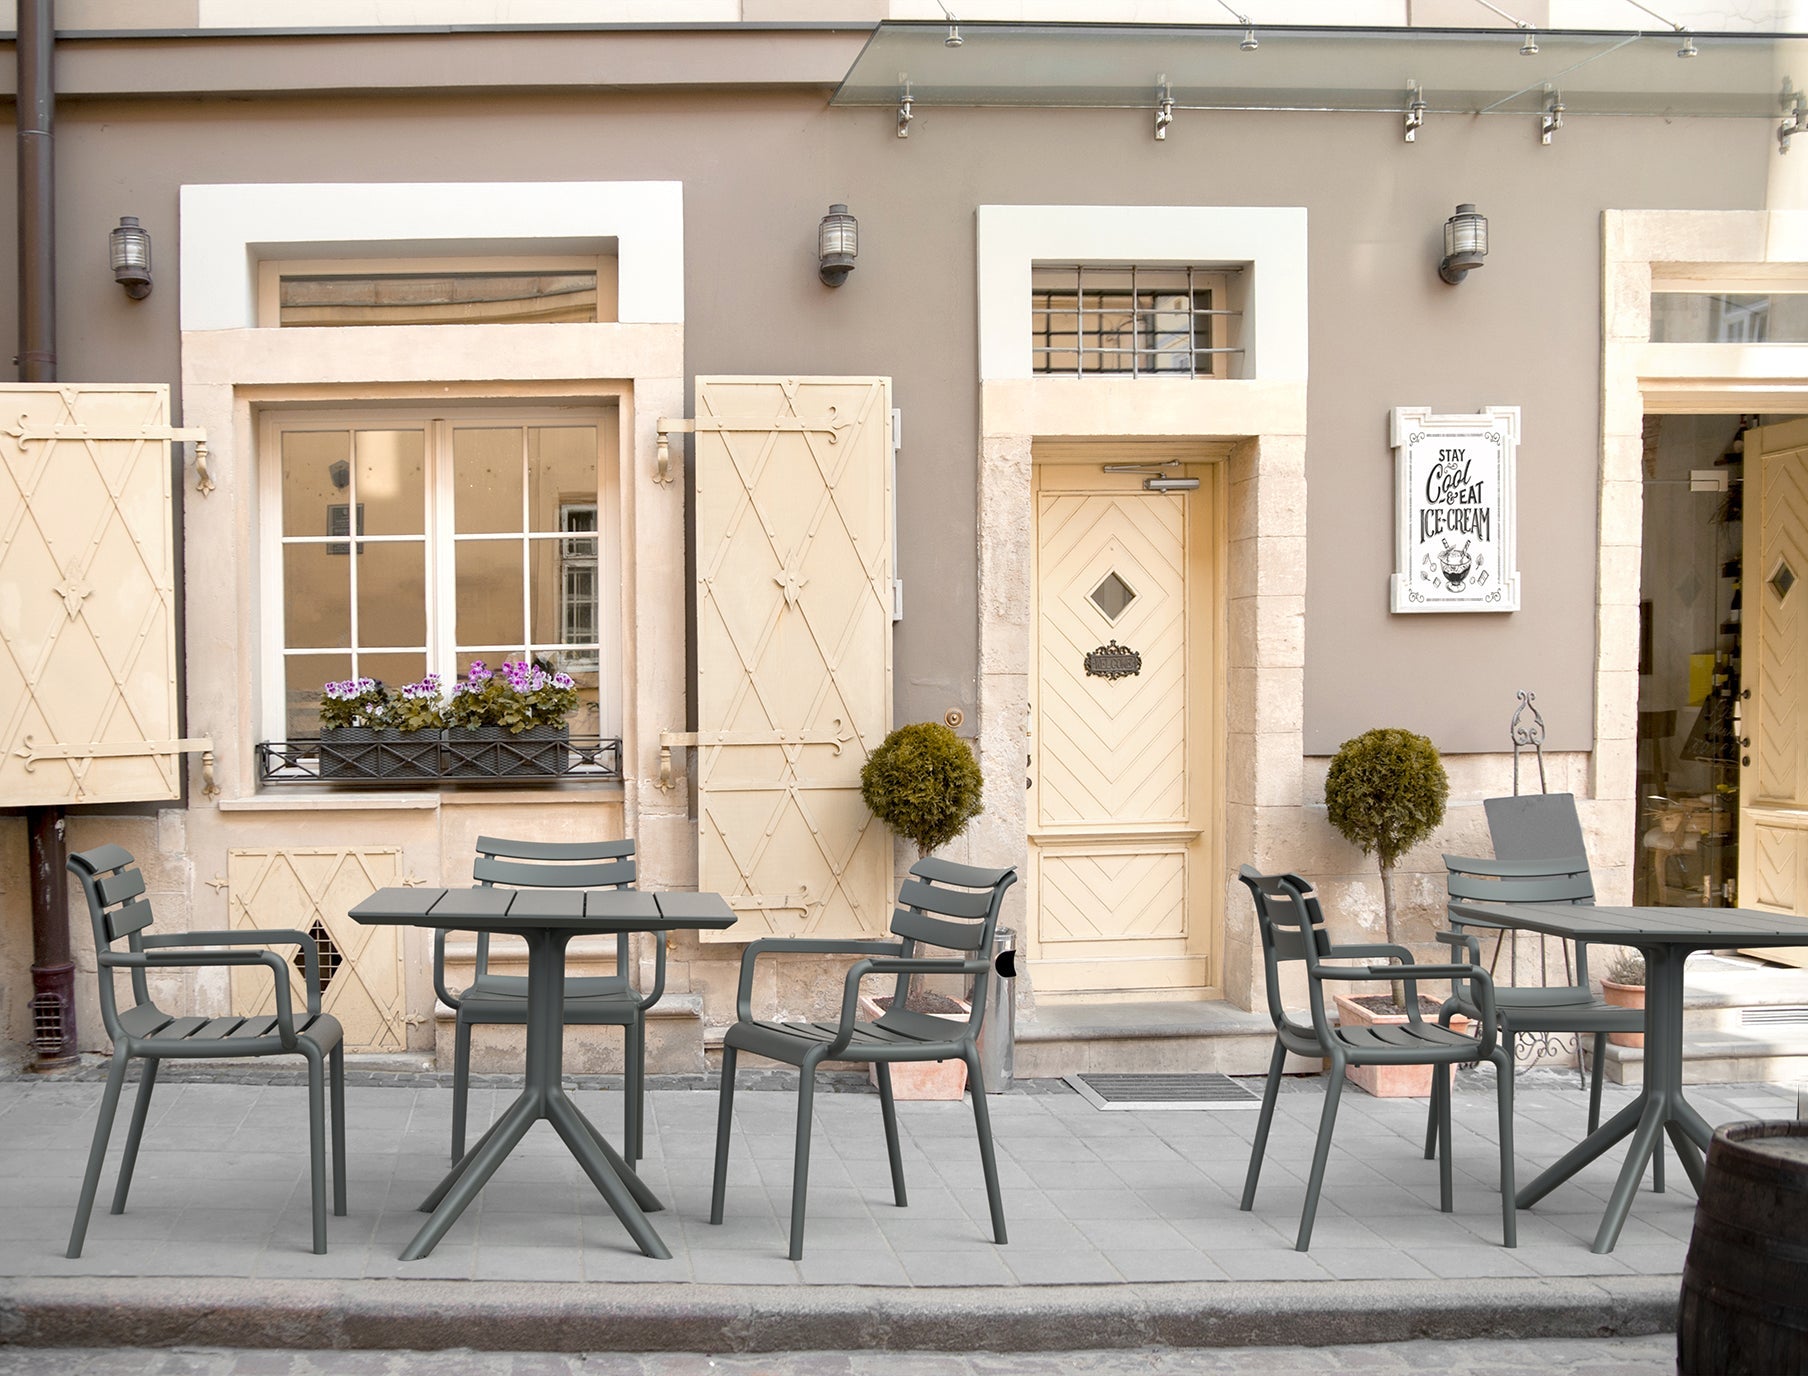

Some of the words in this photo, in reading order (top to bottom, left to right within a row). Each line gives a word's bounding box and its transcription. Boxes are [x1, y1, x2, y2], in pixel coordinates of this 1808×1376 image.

[1438, 448, 1466, 462] STAY
[1425, 458, 1472, 505] Cool
[1446, 490, 1459, 506] &
[1459, 480, 1484, 505] EAT
[1420, 507, 1490, 544] ICE-CREAM
